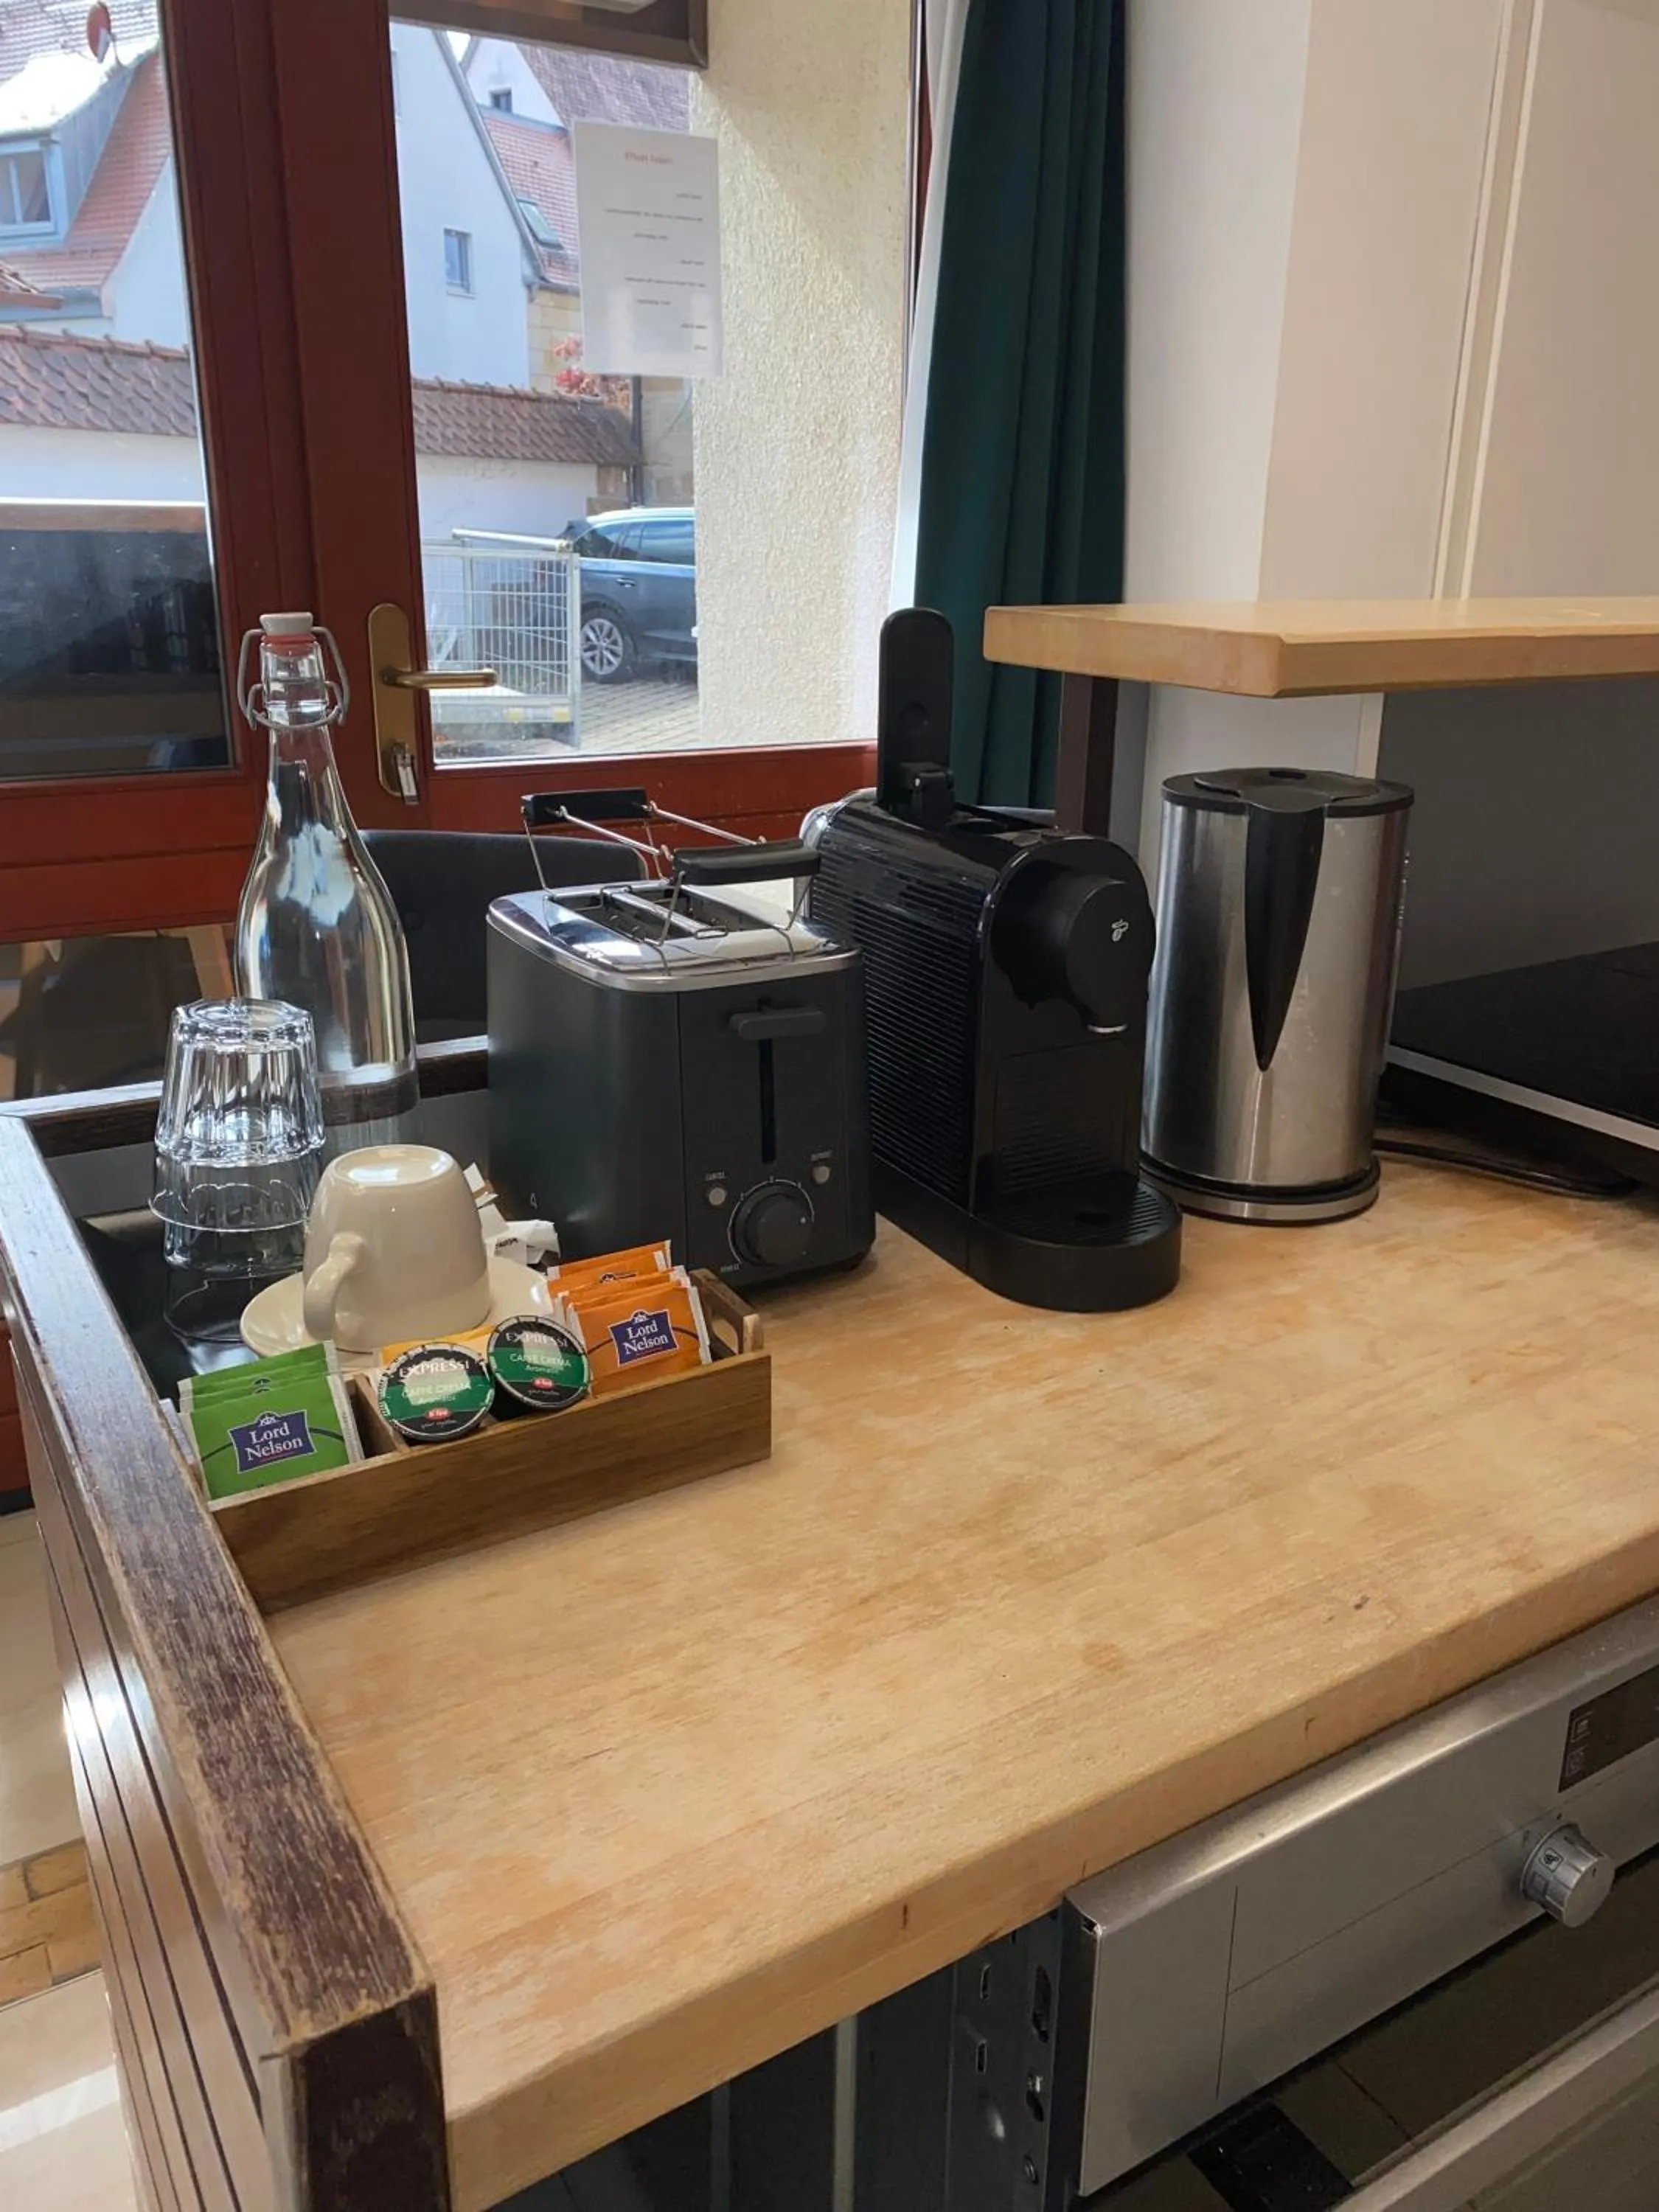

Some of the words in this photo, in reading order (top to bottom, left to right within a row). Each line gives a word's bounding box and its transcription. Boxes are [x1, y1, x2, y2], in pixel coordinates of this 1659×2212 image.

[506, 1331, 568, 1348] EXPRESSI
[627, 1320, 658, 1340] Lord
[623, 1334, 669, 1354] Nelson
[399, 1360, 470, 1378] EXPRESSI
[249, 1422, 290, 1444] Lord
[245, 1437, 303, 1461] Nelson
